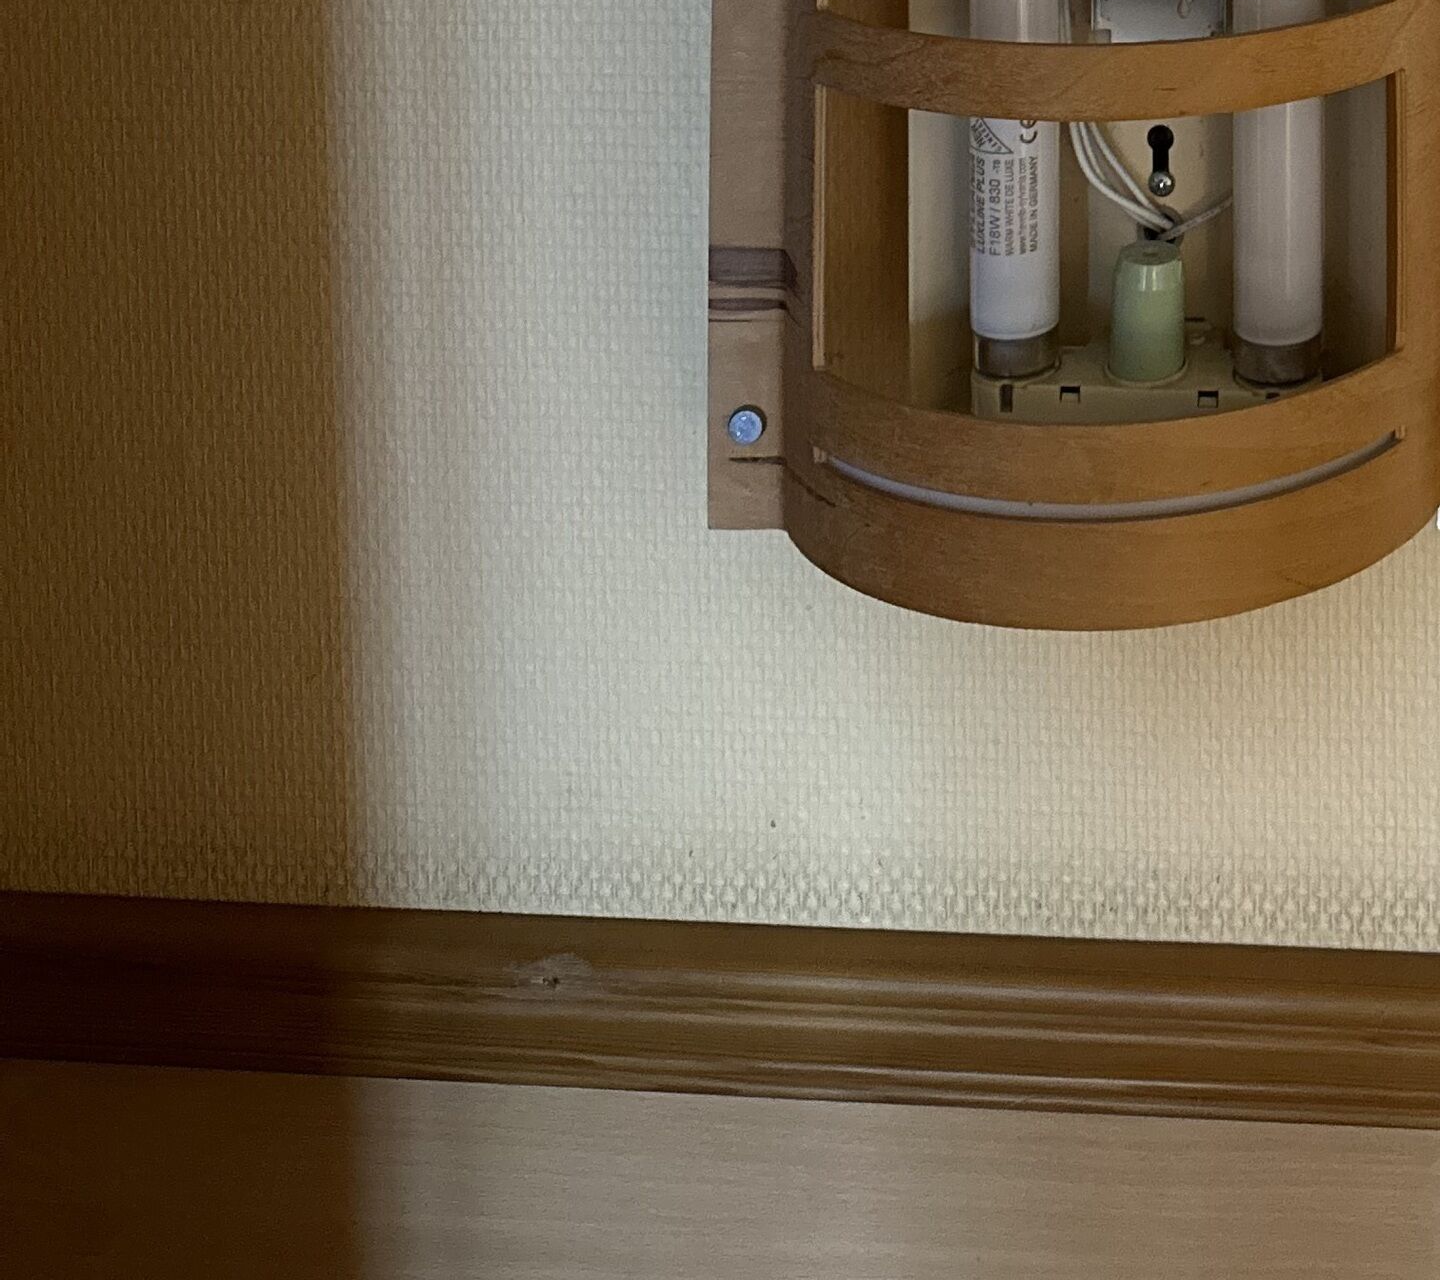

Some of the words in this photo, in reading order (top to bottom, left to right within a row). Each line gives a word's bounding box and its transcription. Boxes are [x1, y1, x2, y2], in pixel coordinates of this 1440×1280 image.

[976, 157, 985, 193] PLUS
[989, 179, 1000, 204] 830
[1029, 156, 1037, 207] GERMANY
[989, 215, 1001, 256] F18W
